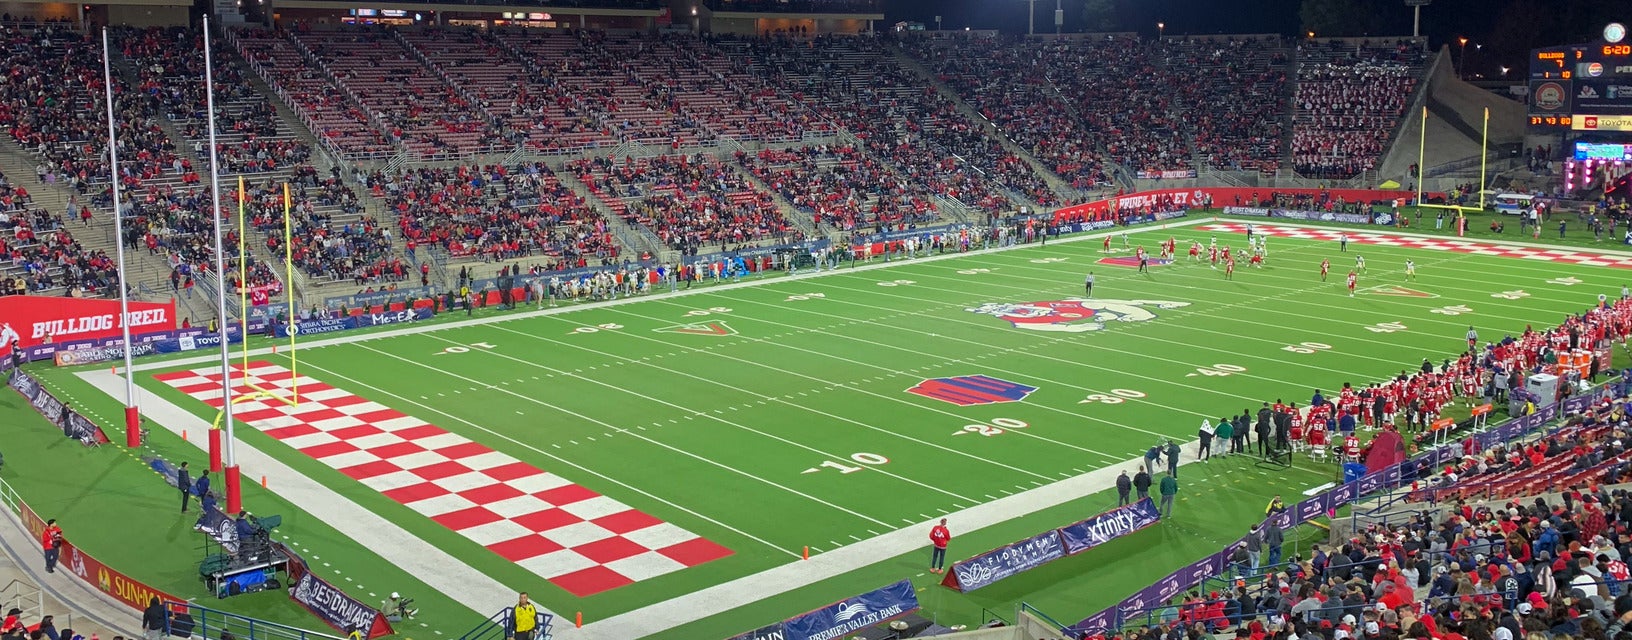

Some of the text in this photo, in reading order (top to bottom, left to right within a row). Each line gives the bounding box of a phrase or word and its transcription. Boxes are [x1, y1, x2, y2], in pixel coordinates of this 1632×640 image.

[1603, 45, 1631, 55] 6:20
[1600, 119, 1632, 127] TOYOTA
[31, 314, 114, 339] BULLDOG
[1087, 388, 1147, 404] 30
[963, 417, 1030, 437] 20
[820, 451, 891, 475] 10
[1088, 510, 1134, 543] xfinity
[988, 534, 1056, 566] FIDDYMENT
[809, 604, 903, 640] PREMIER VALLEY BANK
